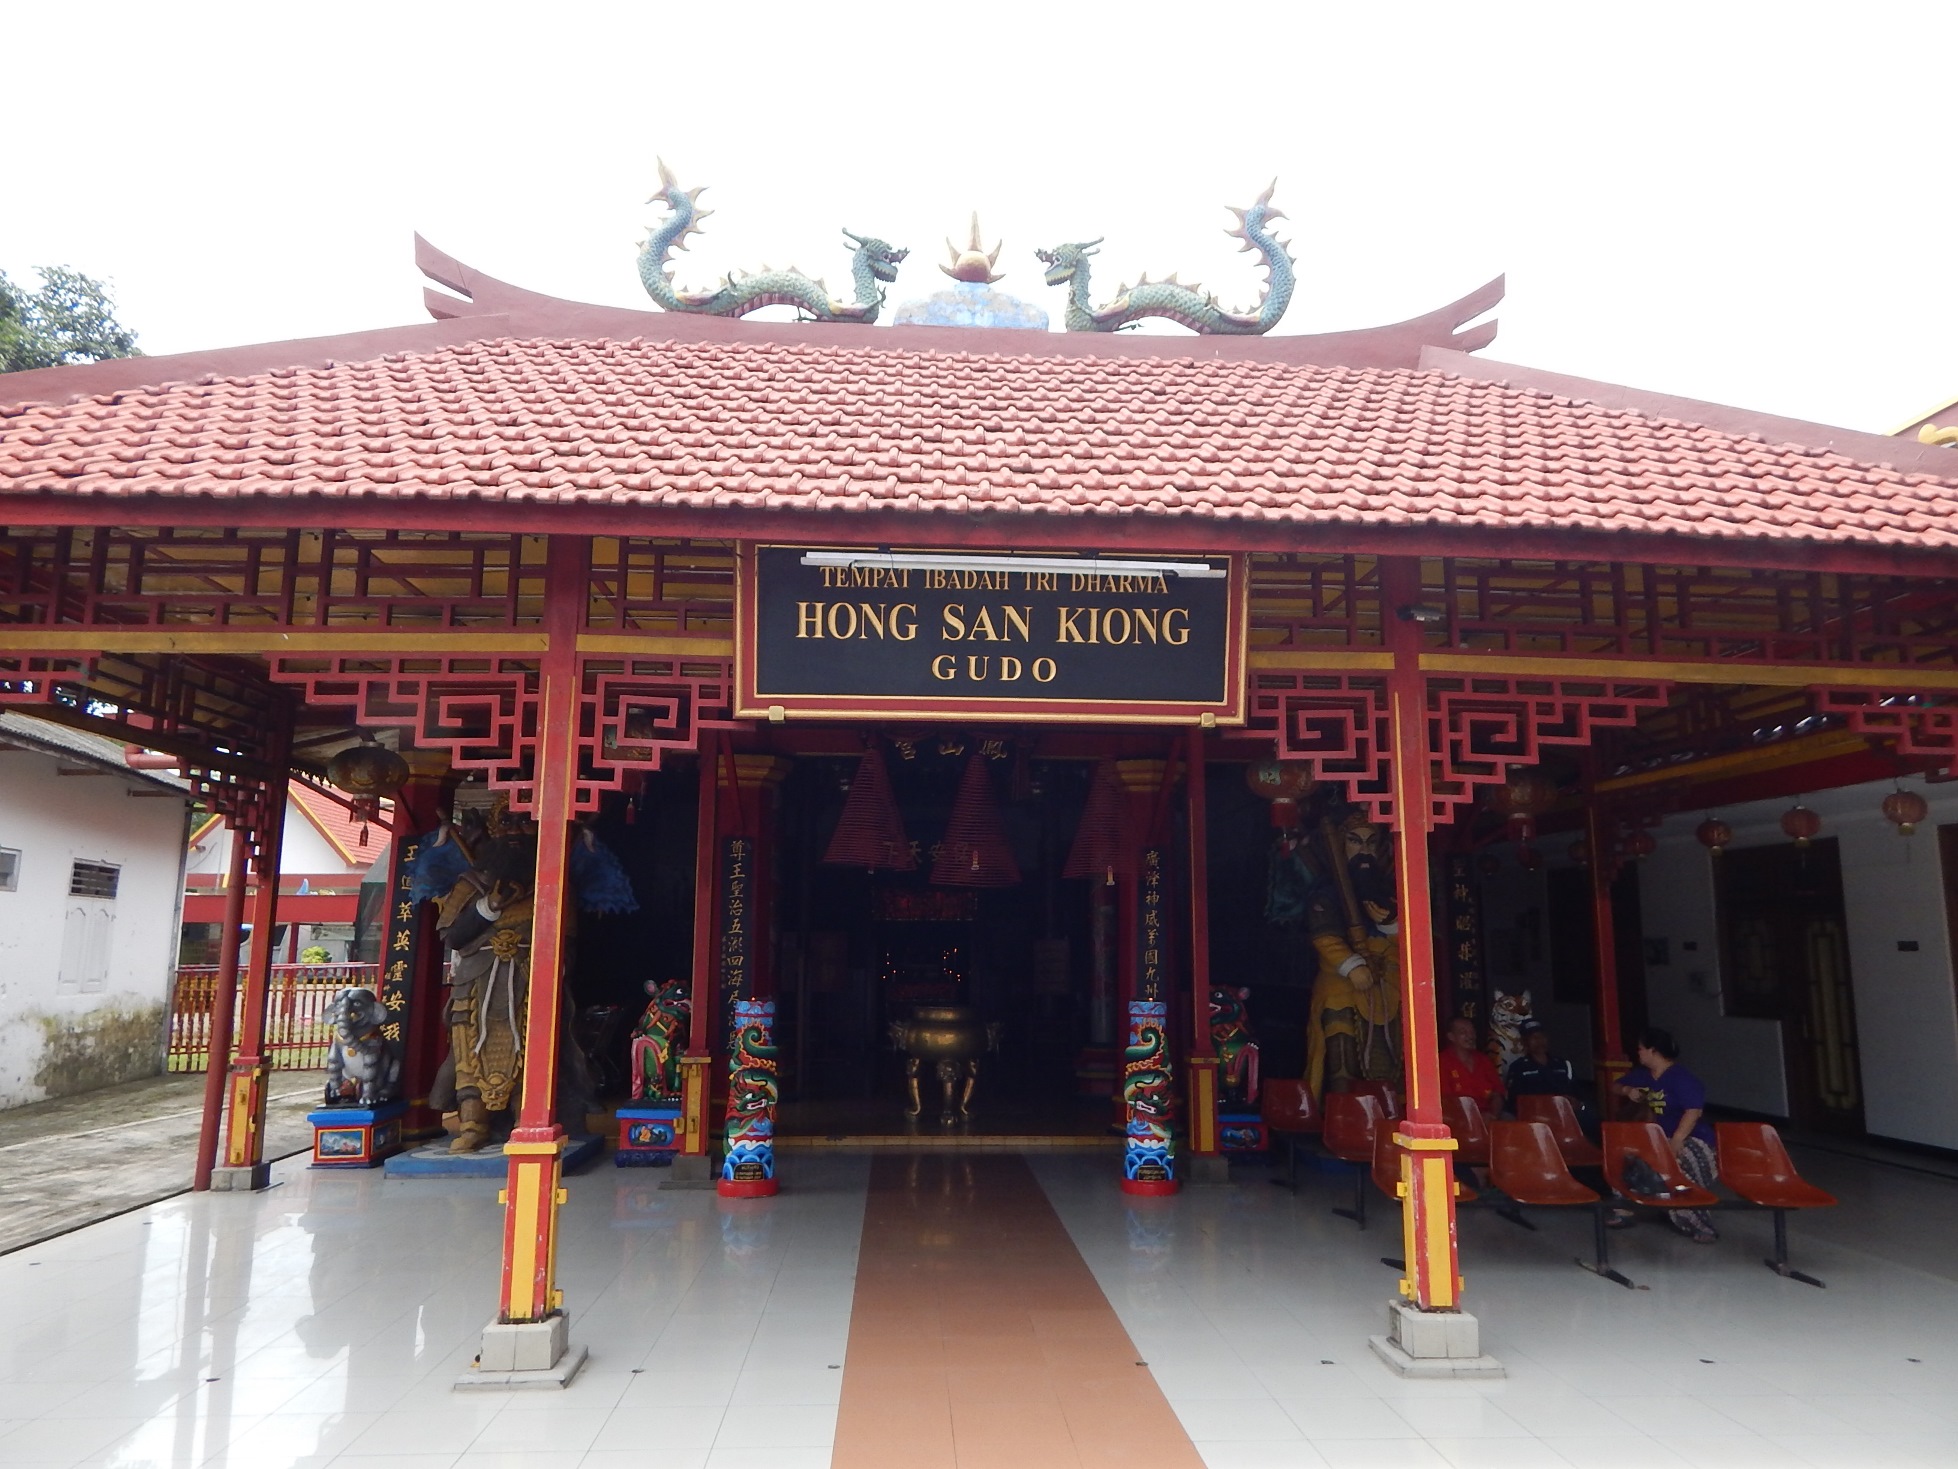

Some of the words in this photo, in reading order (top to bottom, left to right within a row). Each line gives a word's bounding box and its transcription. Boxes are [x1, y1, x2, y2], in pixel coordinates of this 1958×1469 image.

[819, 566, 913, 588] TEMPAT
[924, 568, 1010, 591] IBADAH
[1022, 571, 1059, 592] TRI
[1070, 573, 1169, 594] DHARMA
[795, 600, 919, 641] HONG
[942, 603, 1034, 643] SAN
[1056, 606, 1191, 646] KIONG
[931, 654, 1058, 683] GUDO
